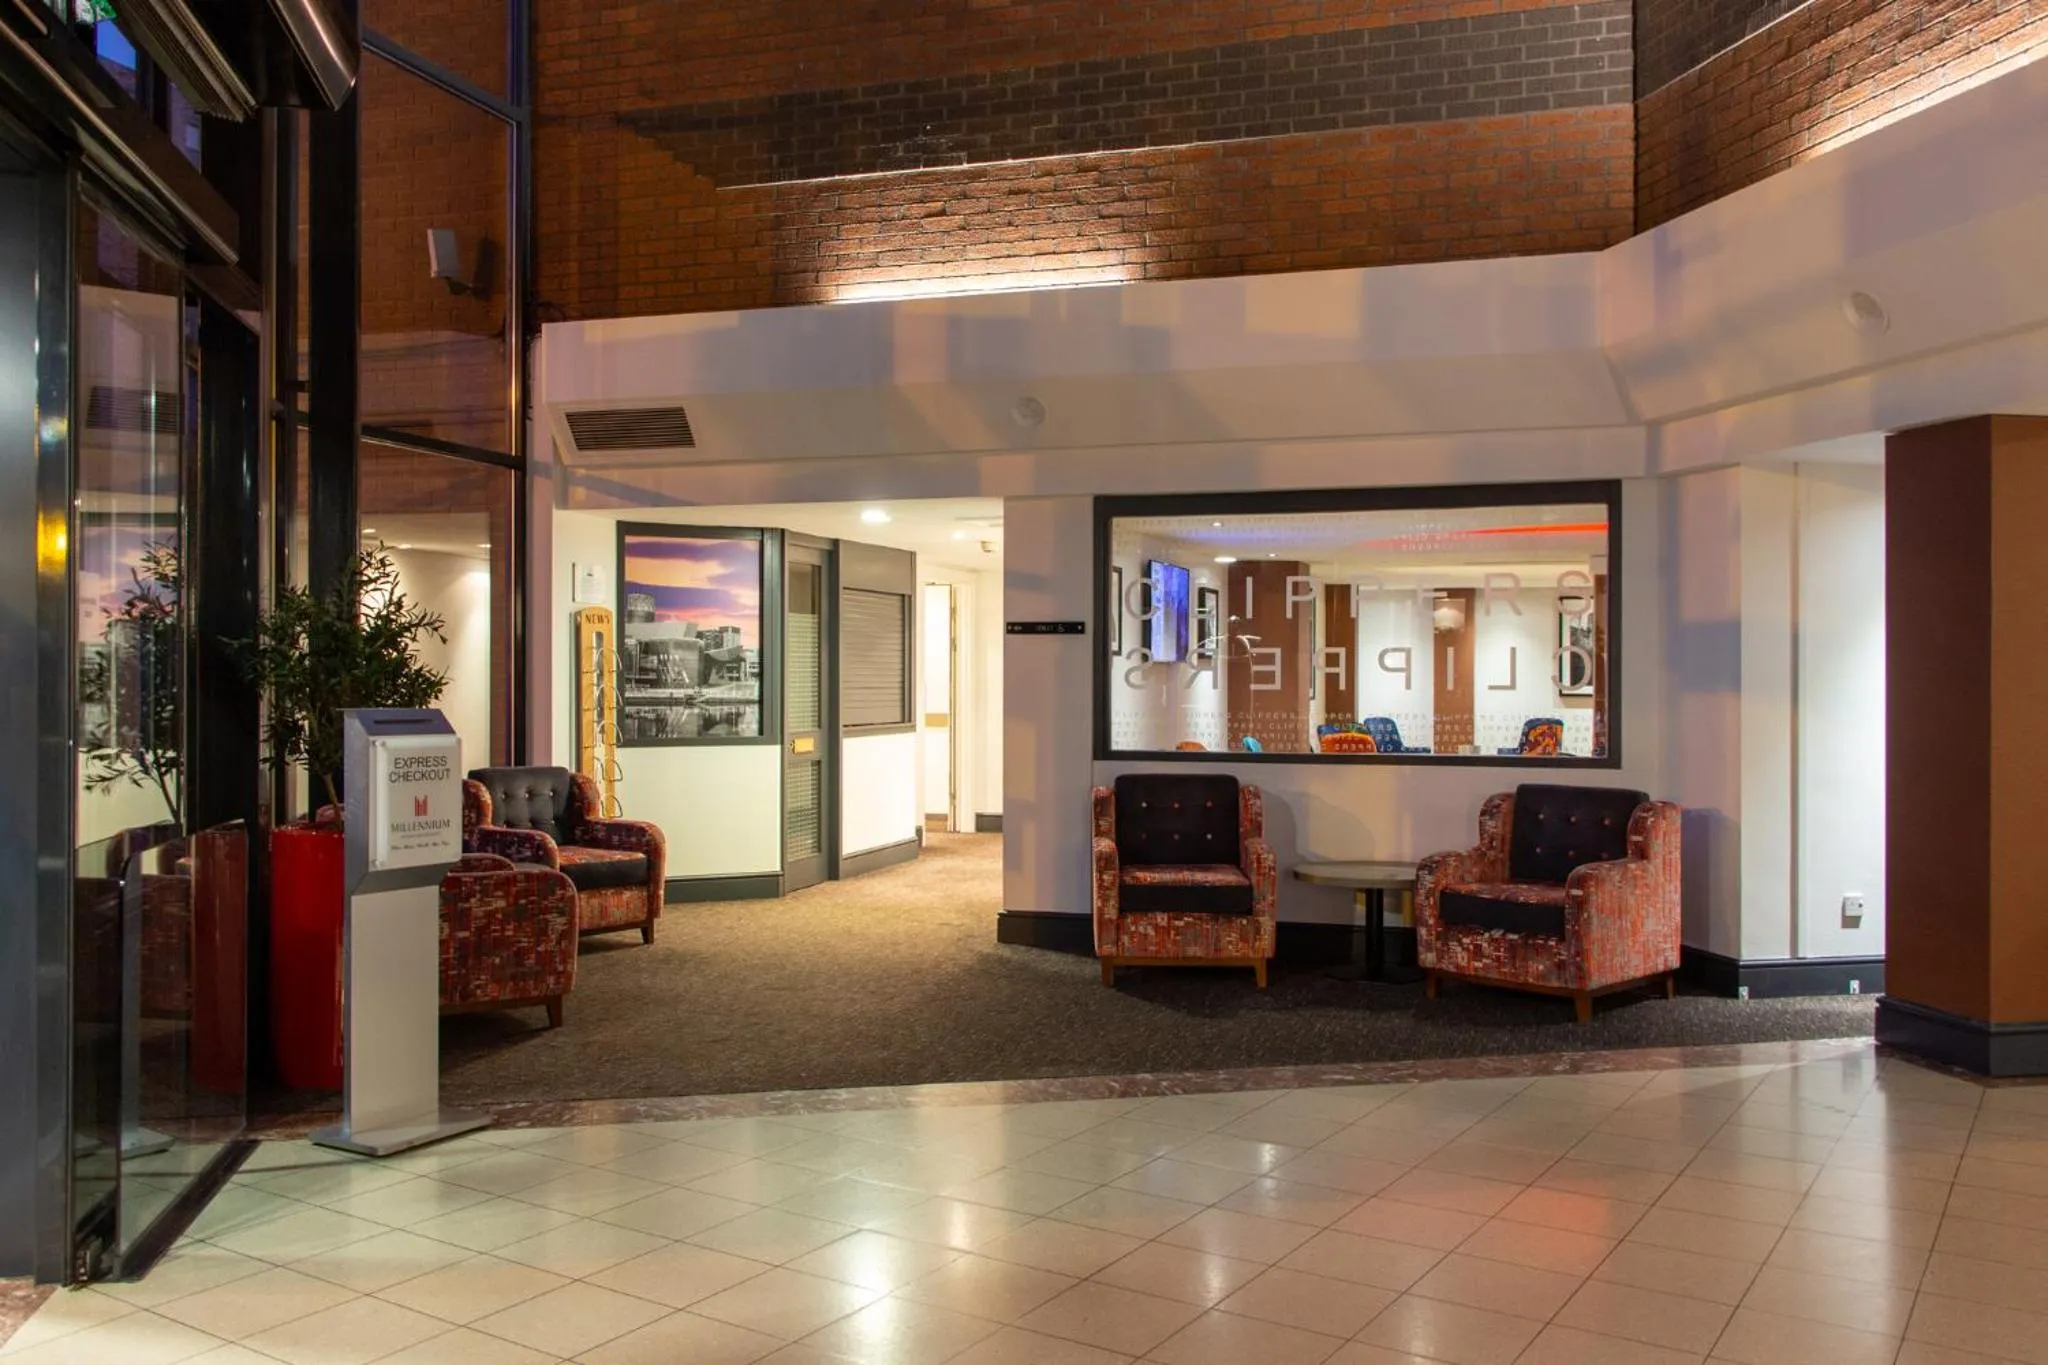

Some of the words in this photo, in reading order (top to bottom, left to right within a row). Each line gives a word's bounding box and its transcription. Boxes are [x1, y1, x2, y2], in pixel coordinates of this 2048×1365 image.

[1125, 569, 1593, 621] CLIPPERS
[394, 755, 448, 769] EXPRESS
[389, 768, 450, 783] CHECKOUT
[391, 819, 450, 831] MILLENNIUM
